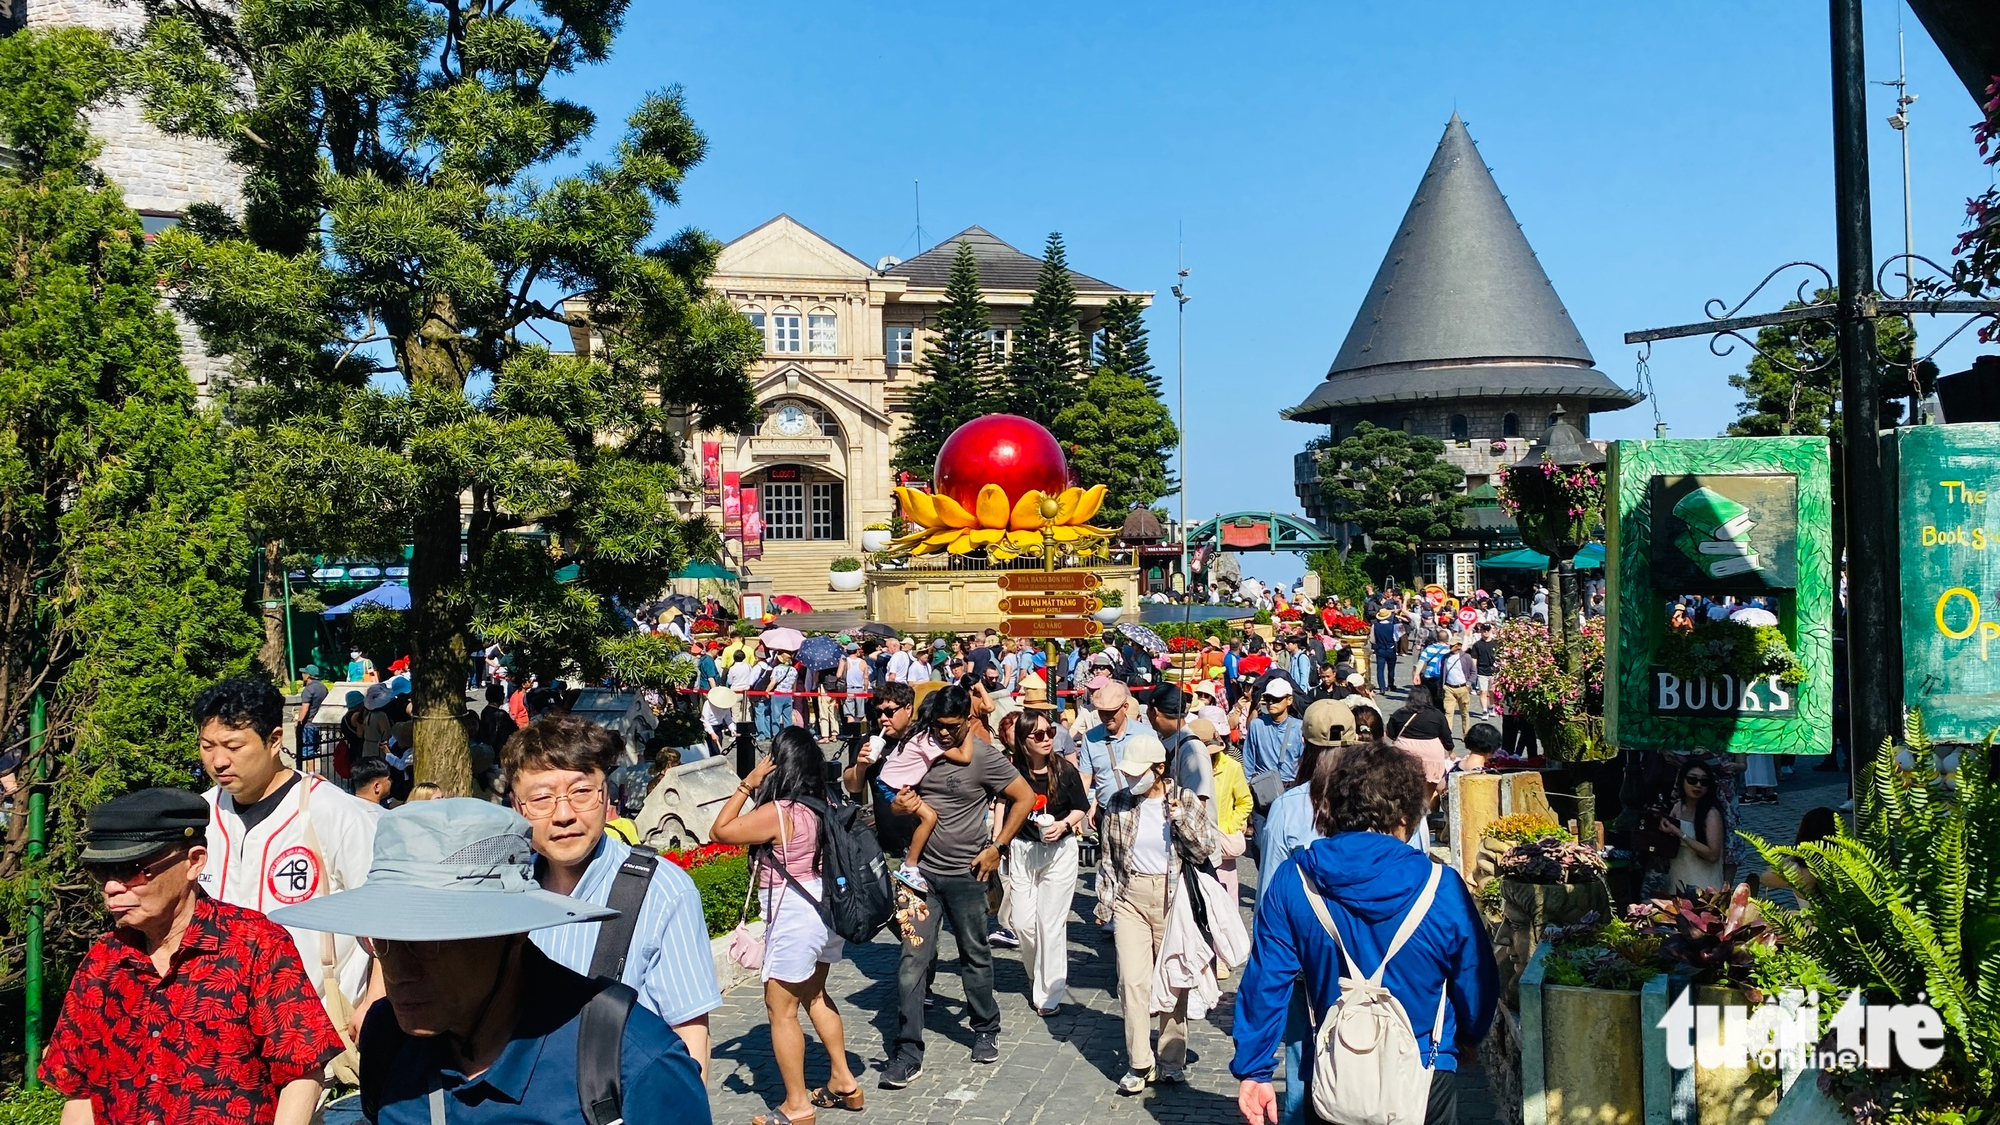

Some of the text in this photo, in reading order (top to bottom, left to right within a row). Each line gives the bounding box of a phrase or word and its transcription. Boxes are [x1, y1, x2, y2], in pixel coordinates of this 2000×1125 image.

[762, 442, 785, 450] GARE
[1939, 480, 1987, 504] The
[1657, 673, 1790, 711] BOOKS
